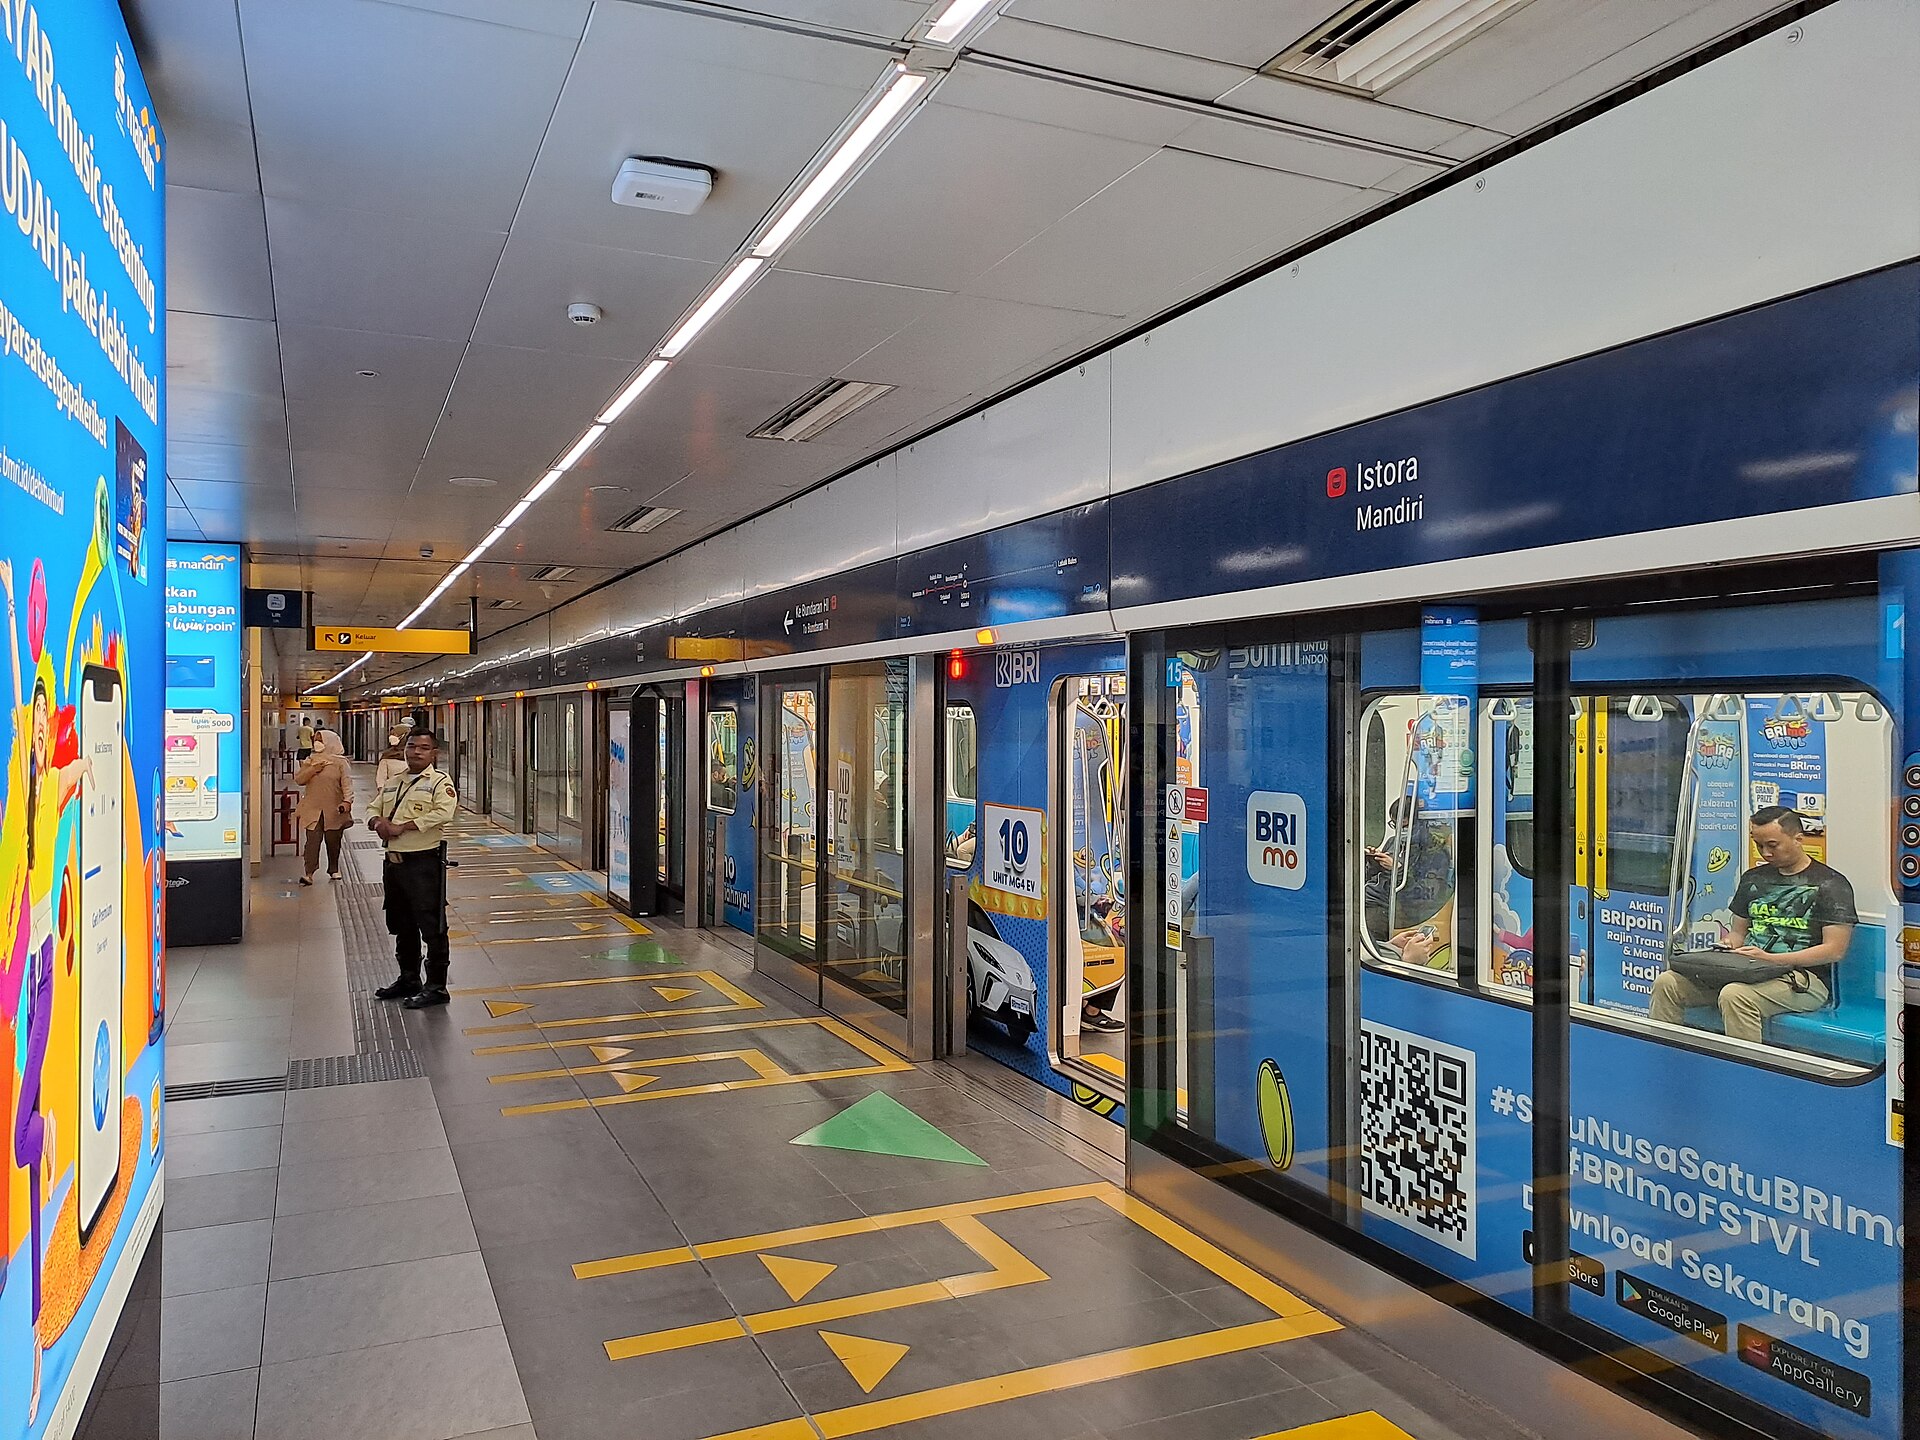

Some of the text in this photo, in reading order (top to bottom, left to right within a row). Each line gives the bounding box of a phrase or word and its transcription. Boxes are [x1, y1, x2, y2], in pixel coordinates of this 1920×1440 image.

[127, 94, 155, 191] mandiri
[57, 83, 102, 219] music
[103, 183, 155, 334] streaming
[62, 241, 98, 338] pake
[99, 290, 129, 385] debit
[129, 345, 158, 426] virtual
[1357, 456, 1419, 492] Istora
[1356, 494, 1424, 531] Mandiri
[179, 560, 224, 570] mandiri
[802, 601, 823, 617] Bundaran
[823, 598, 829, 612] HI
[355, 633, 377, 641] Keluar
[1012, 650, 1040, 684] BRI
[1167, 664, 1182, 683] 15
[1764, 723, 1807, 740] BRImo
[1778, 771, 1821, 780] Hadiahnya!
[1790, 761, 1821, 771] BRImo
[1755, 785, 1774, 794] GRAND
[1756, 794, 1773, 803] PRIZE
[1803, 797, 1816, 805] 10
[1255, 811, 1297, 845] BRI
[998, 818, 1029, 867] 10
[1263, 846, 1298, 870] mo
[992, 870, 1036, 893] UNIT MG4 EV
[1628, 900, 1664, 914] Aktifin
[1600, 908, 1663, 932] BRIpoin
[1606, 930, 1665, 949] Rajin Trans
[1623, 946, 1632, 956] &
[1568, 1265, 1599, 1288] Store
[1647, 1288, 1689, 1312] TEMUKAN DI
[1681, 1247, 1870, 1360] Sekarang
[1647, 1300, 1720, 1344] Google Play
[1771, 1343, 1807, 1366] EXPLORE
[1821, 1366, 1835, 1377] ON
[1771, 1356, 1863, 1408] AppGallery
